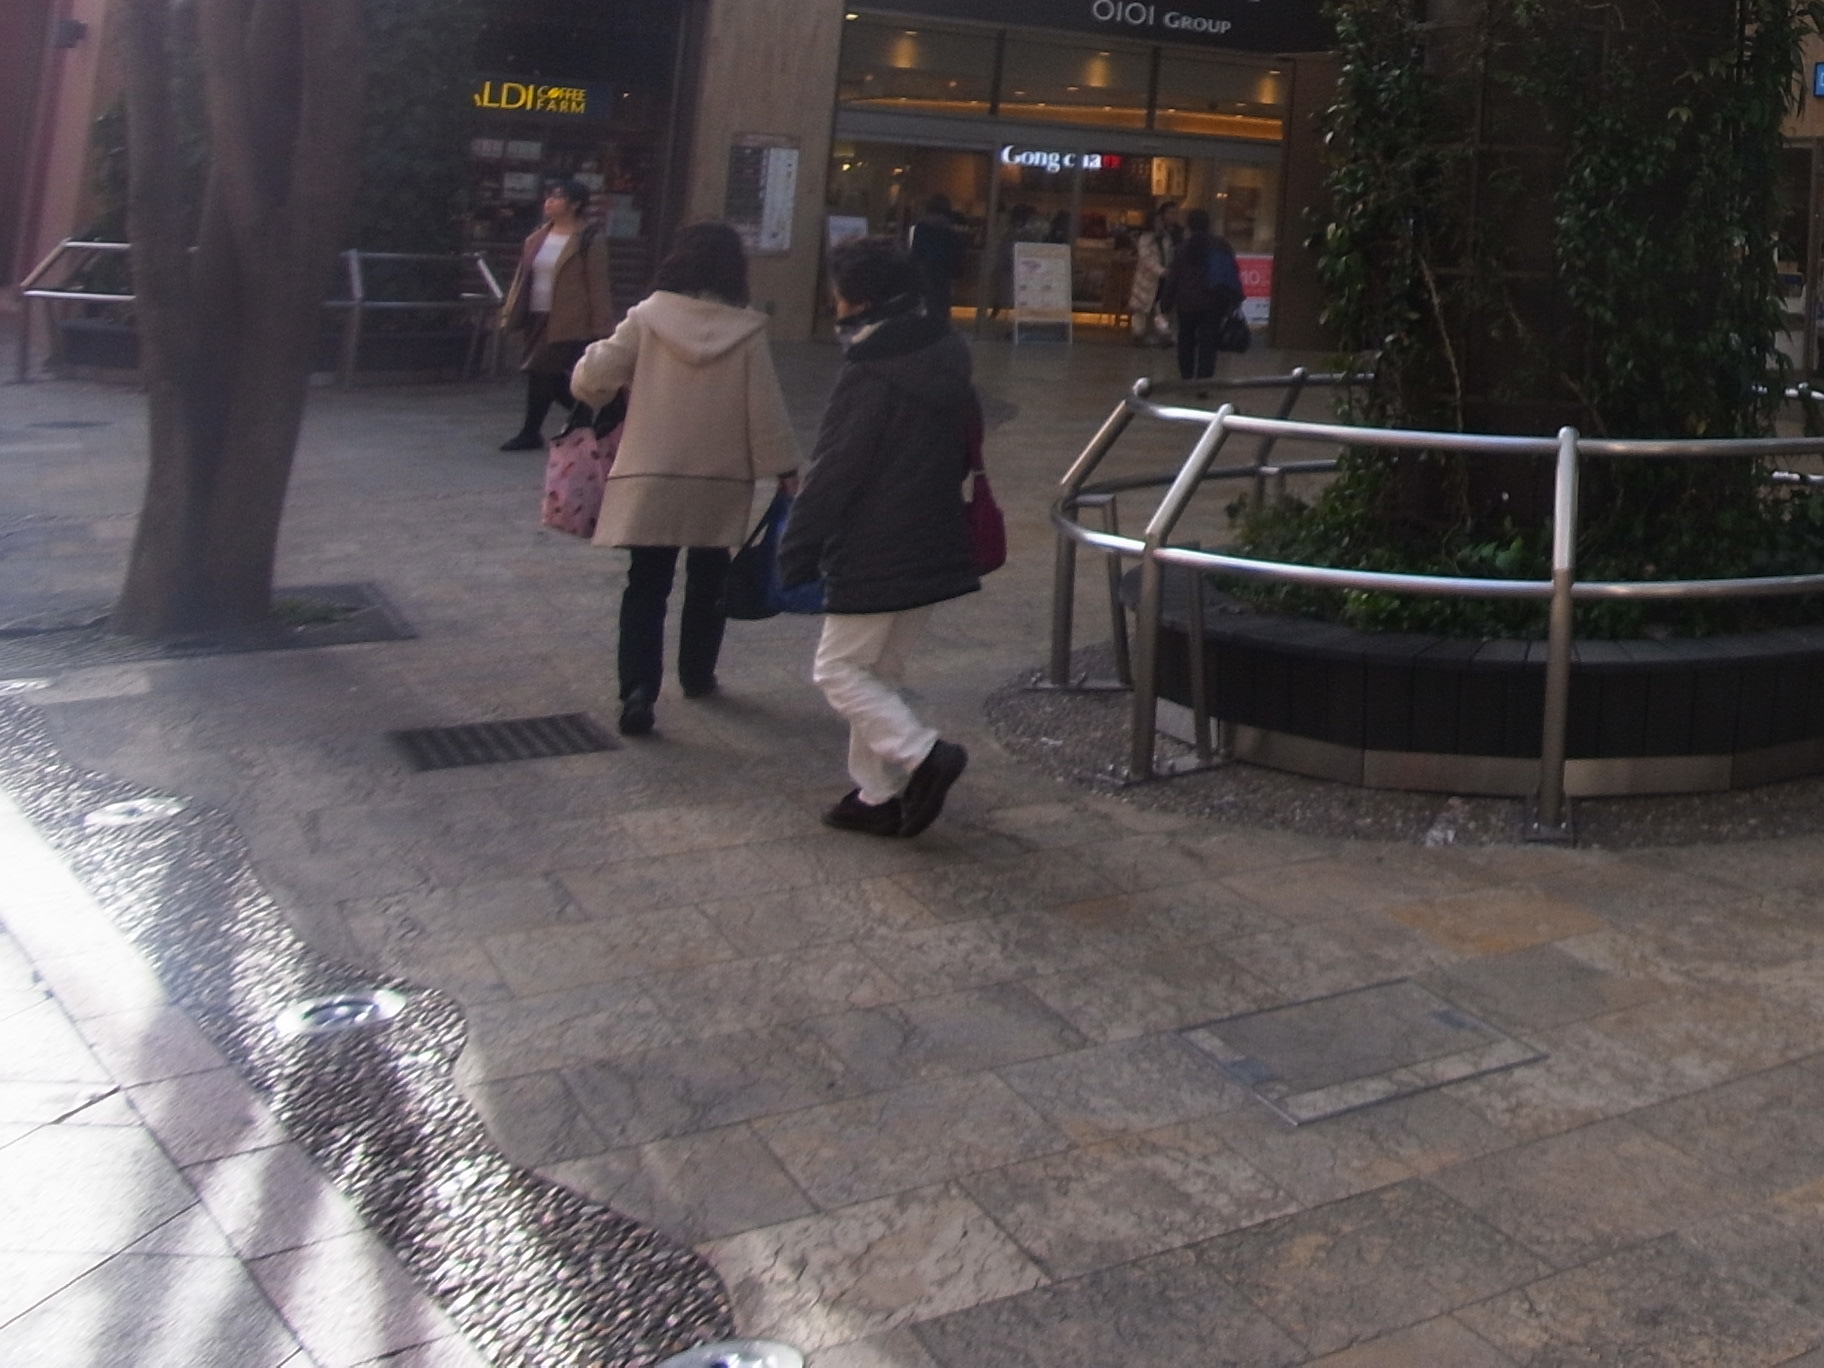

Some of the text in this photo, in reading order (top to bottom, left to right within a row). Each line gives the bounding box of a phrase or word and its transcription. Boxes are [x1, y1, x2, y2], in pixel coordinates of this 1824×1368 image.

[1163, 11, 1231, 34] GROUP
[474, 81, 535, 110] LDI
[535, 98, 586, 114] FARM
[1000, 144, 1061, 173] Gong
